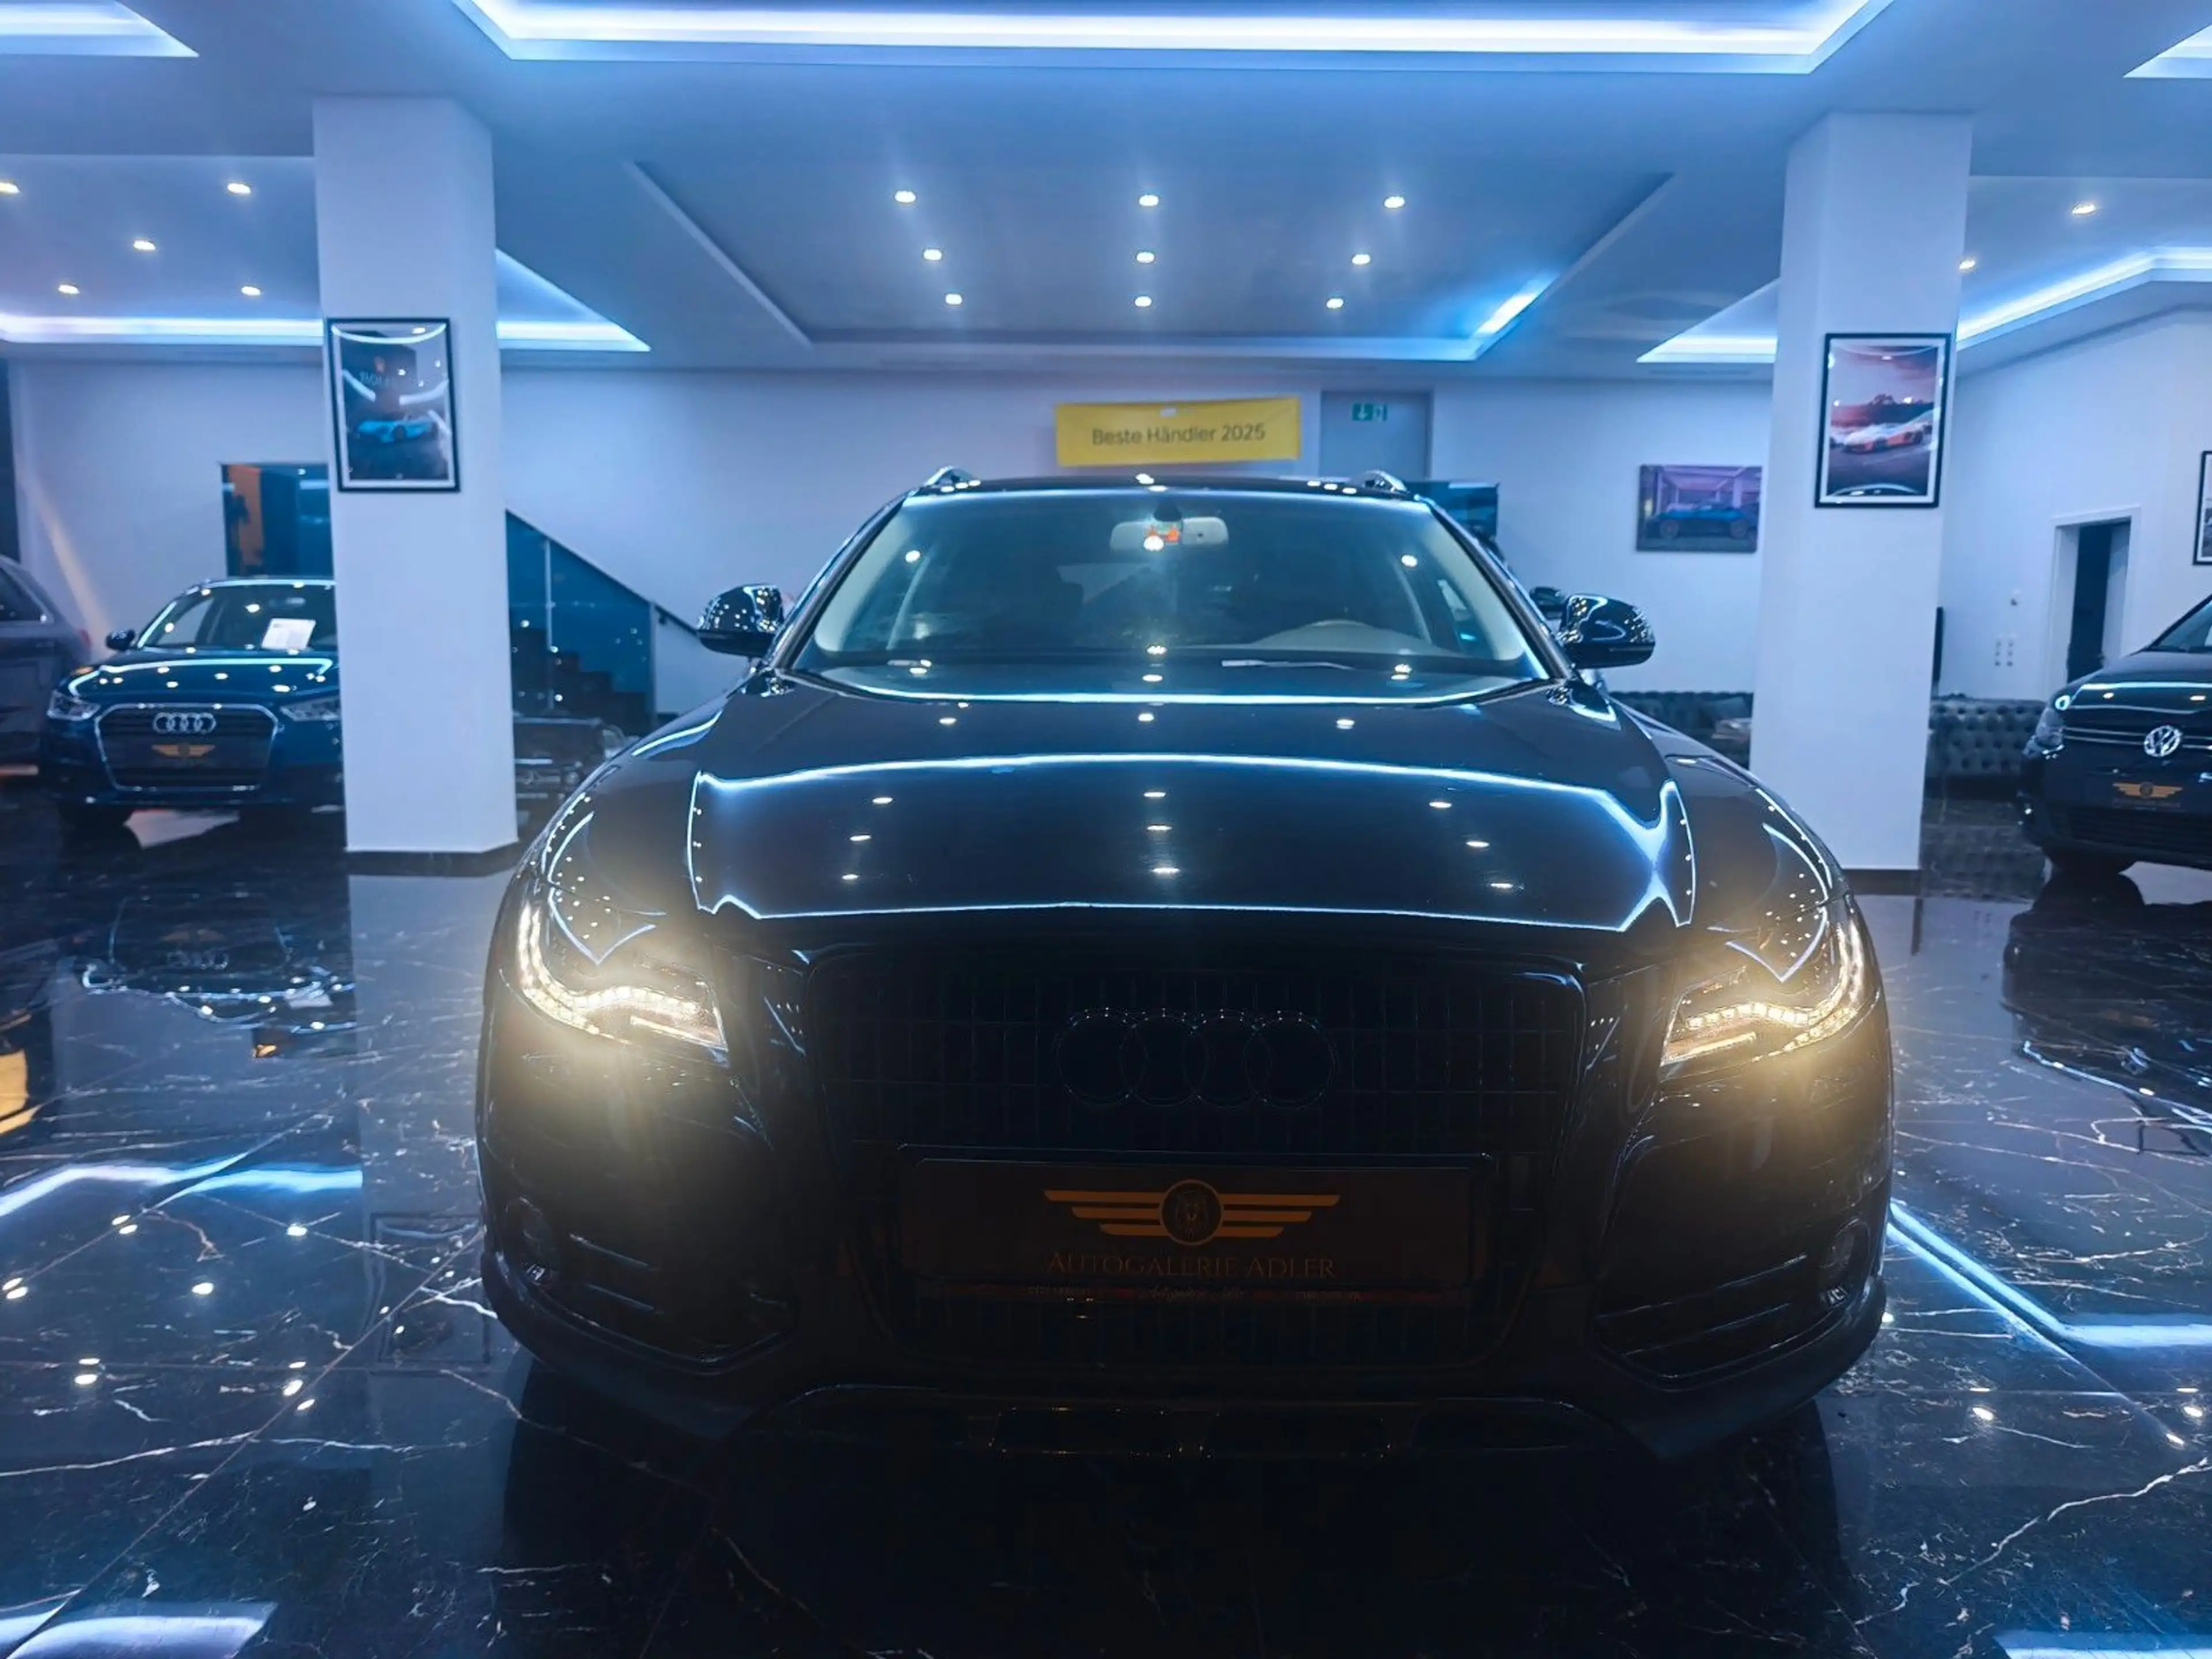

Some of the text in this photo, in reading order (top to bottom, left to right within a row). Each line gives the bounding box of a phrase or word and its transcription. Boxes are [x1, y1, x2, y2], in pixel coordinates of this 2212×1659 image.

[1092, 423, 1265, 446] Beste Händler 2025
[1048, 1251, 1336, 1279] AUTOGALERIE ADLER
